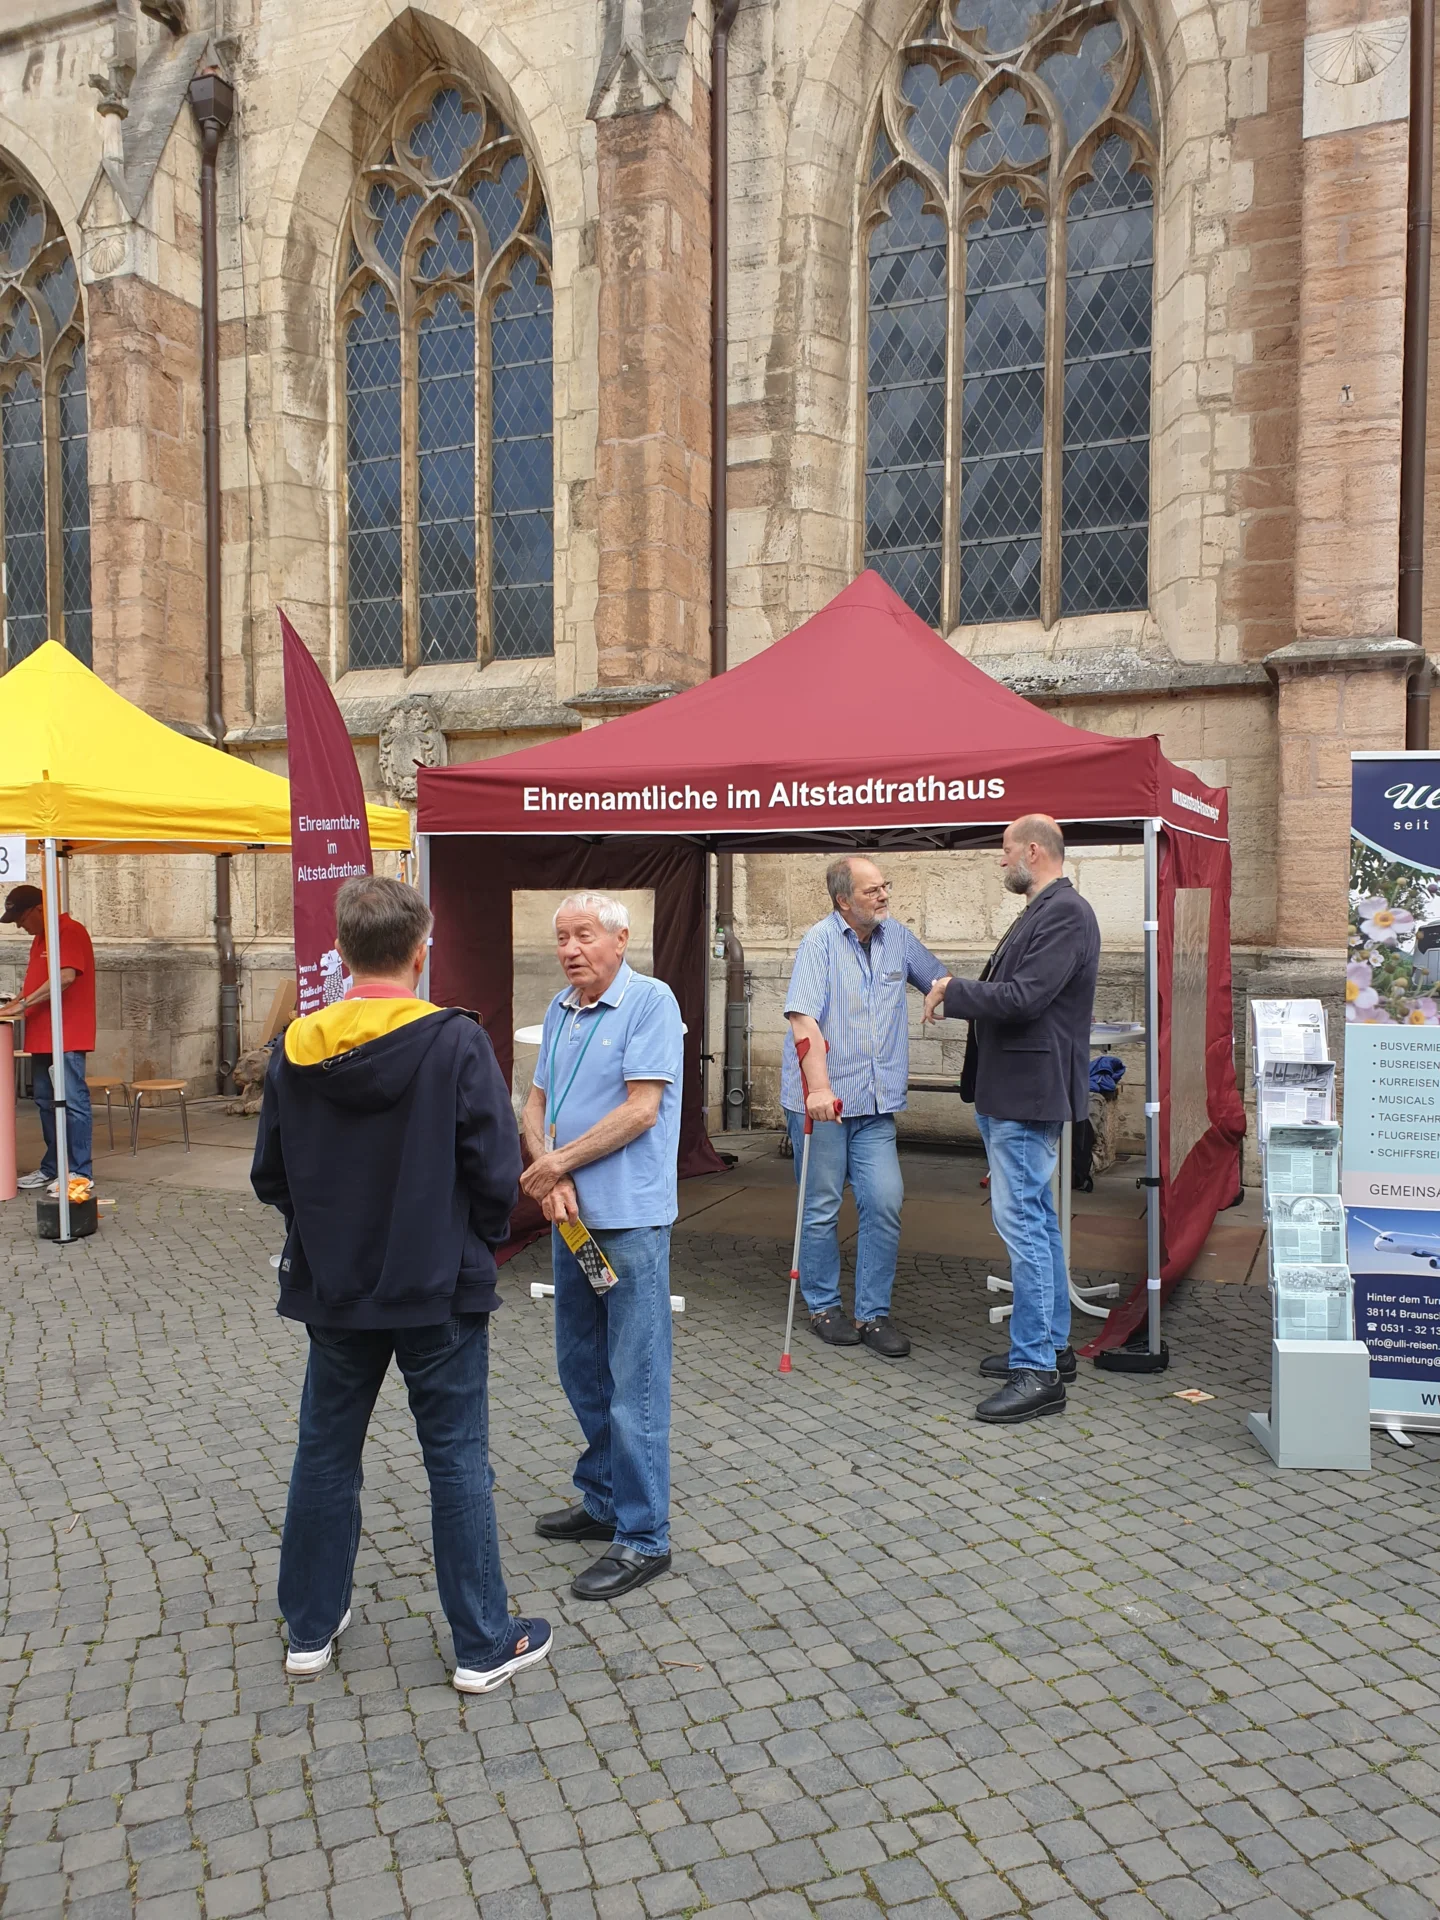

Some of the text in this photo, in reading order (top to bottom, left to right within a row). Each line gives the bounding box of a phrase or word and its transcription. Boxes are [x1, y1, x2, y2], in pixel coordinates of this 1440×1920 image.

[523, 775, 1006, 811] Ehrenamtliche im Altstadtrathaus
[1393, 819, 1429, 830] seit
[326, 839, 338, 855] im
[297, 861, 367, 882] Altstadtrathaus
[1380, 1059, 1440, 1070] BUSREISEN
[1379, 1077, 1440, 1088] KURREISEN
[1378, 1095, 1435, 1106] MUSICALS
[1377, 1148, 1440, 1159] SCHIFFSREI
[1366, 1292, 1396, 1303] Hinter
[1398, 1295, 1421, 1304] dem
[1366, 1307, 1397, 1318] 38114
[1380, 1323, 1405, 1334] 0531
[1414, 1325, 1427, 1335] 32
